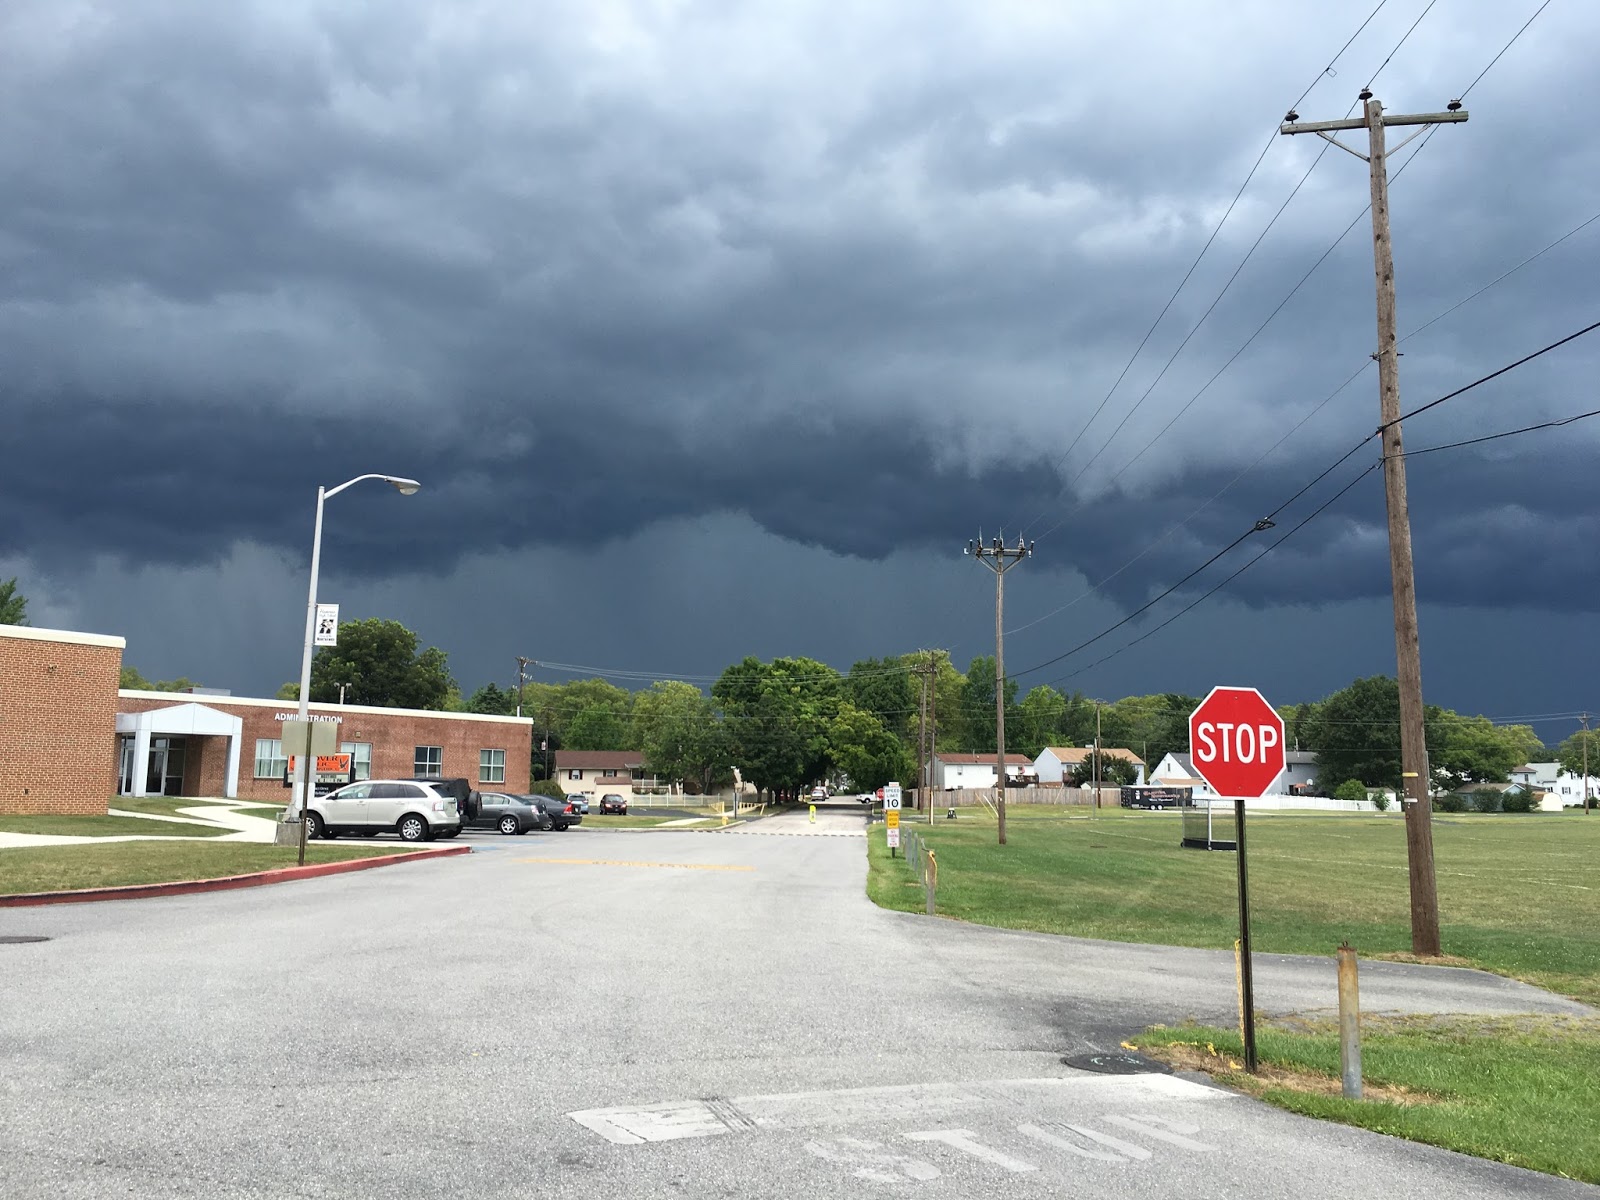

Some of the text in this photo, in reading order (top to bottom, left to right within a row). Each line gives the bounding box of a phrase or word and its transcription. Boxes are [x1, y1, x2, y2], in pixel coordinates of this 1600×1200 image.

[274, 712, 343, 724] ADMINSTRATION
[1197, 721, 1278, 764] STOP
[887, 799, 899, 808] 10
[802, 1113, 1220, 1184] STOP
